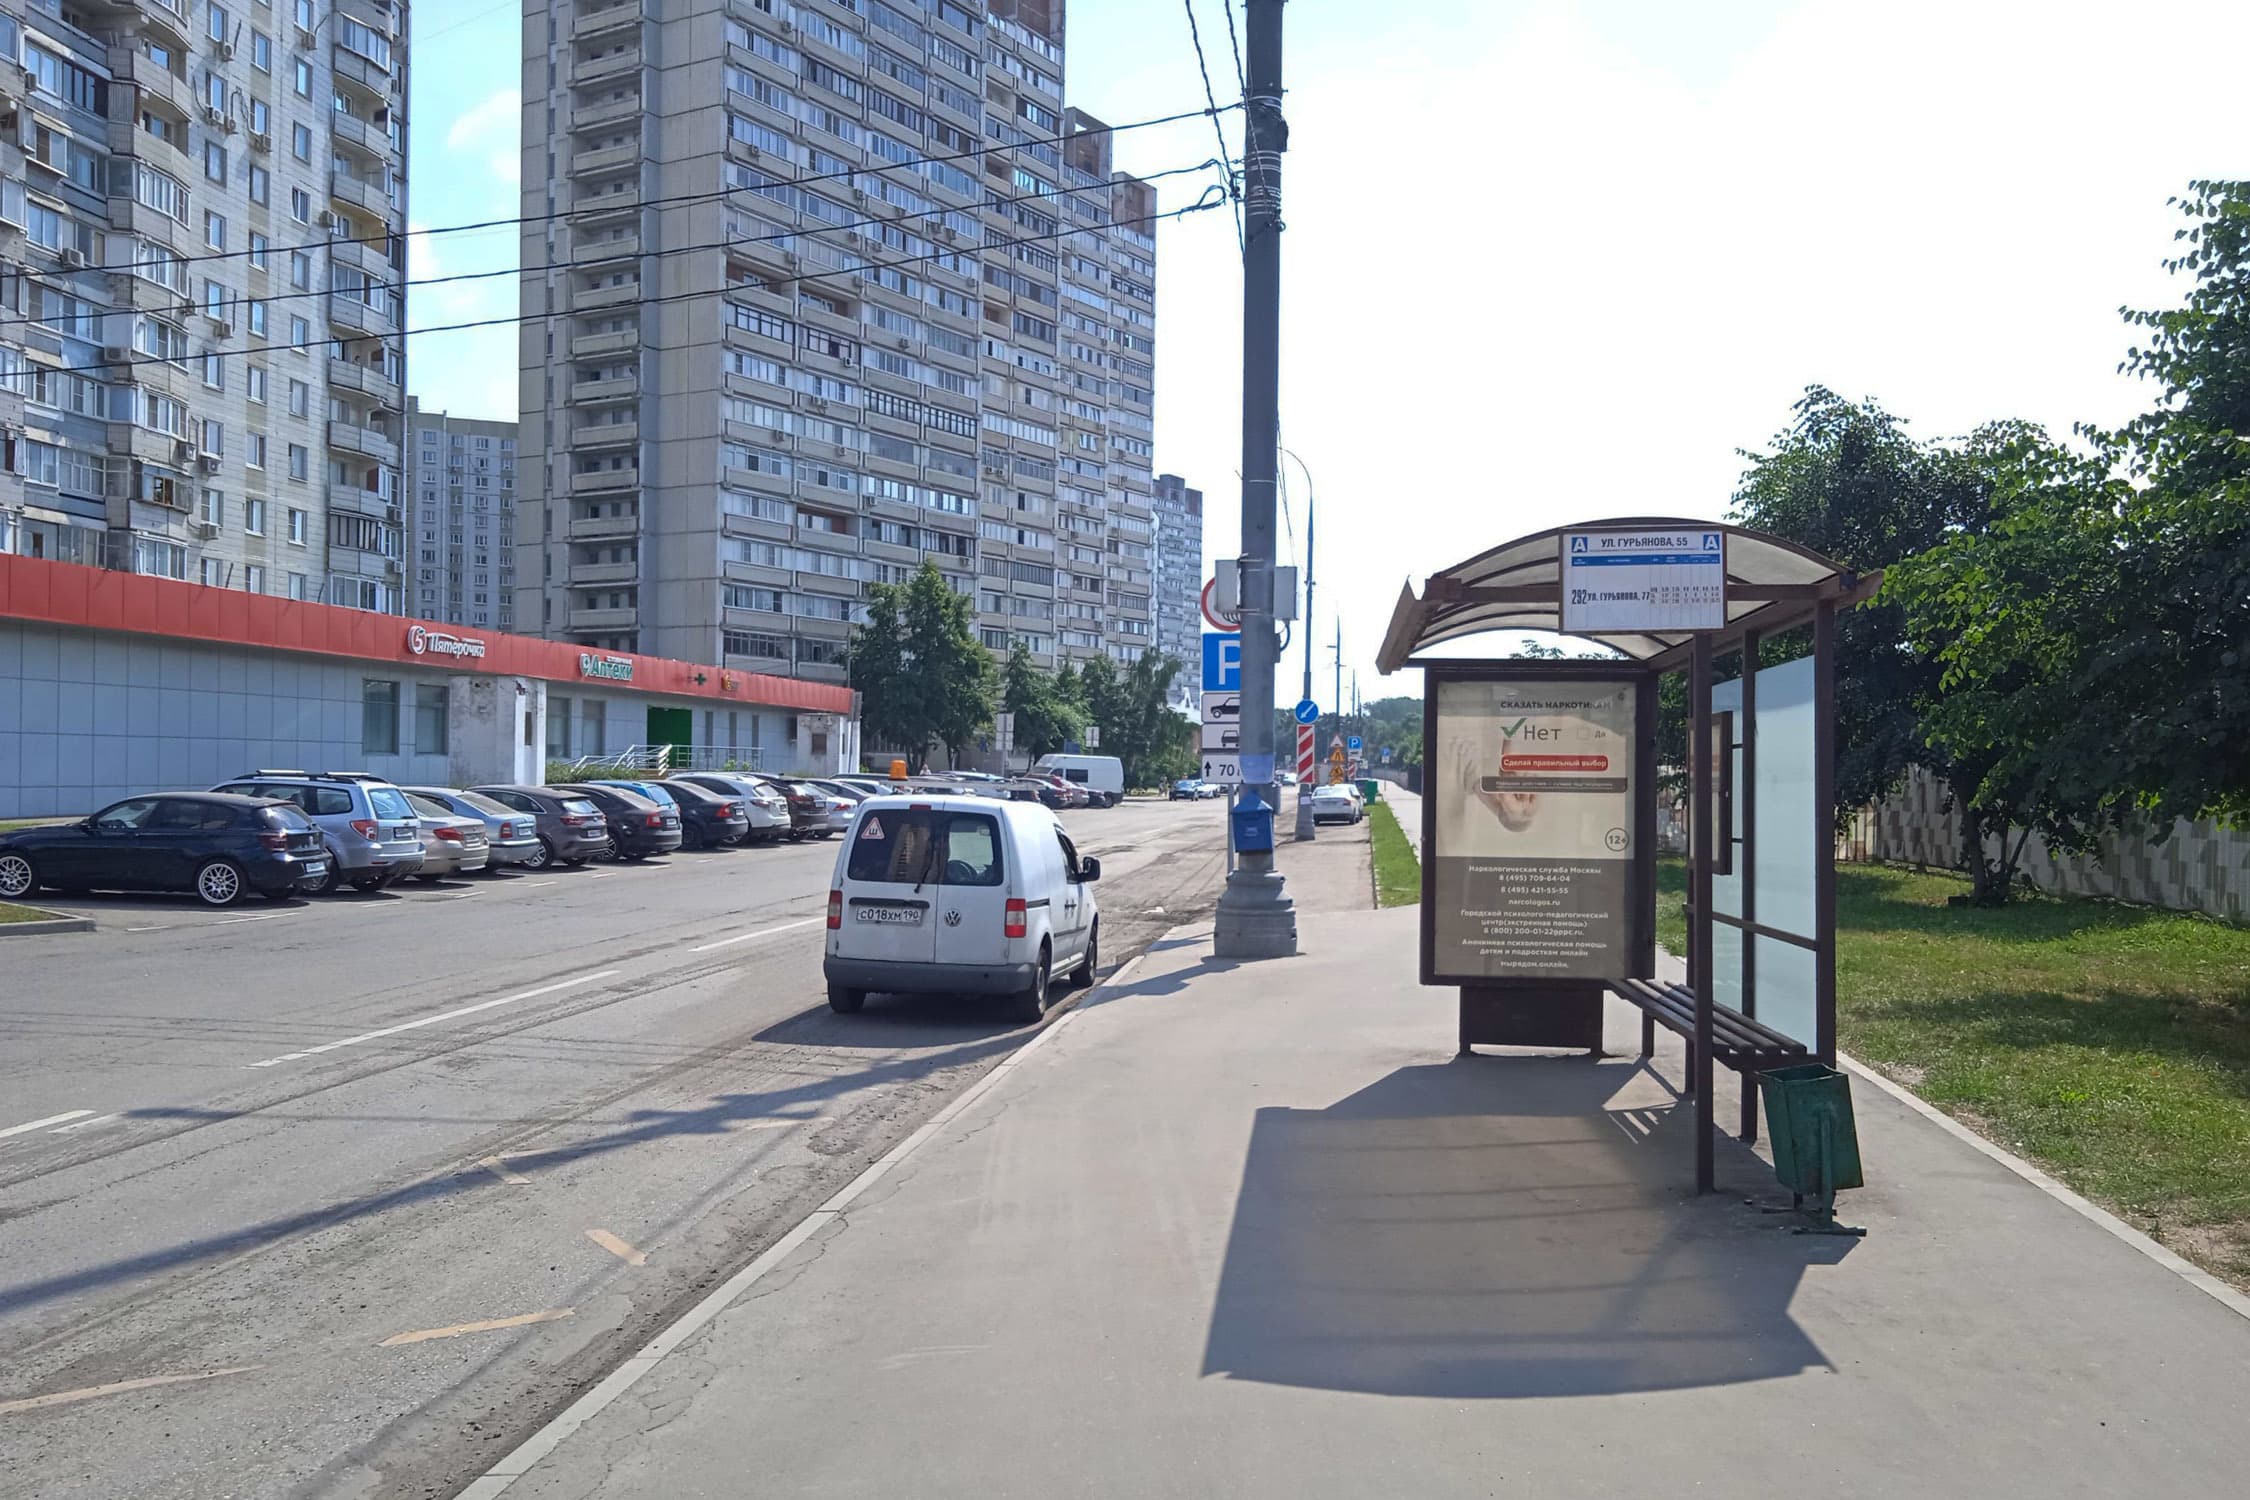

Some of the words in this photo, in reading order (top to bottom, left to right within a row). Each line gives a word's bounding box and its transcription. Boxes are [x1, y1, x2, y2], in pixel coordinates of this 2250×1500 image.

[1601, 538, 1616, 548] УЛ.
[1618, 536, 1675, 548] ГУРЬЯНОВА,
[1677, 536, 1688, 546] 55
[1571, 589, 1587, 605] 292
[1587, 591, 1599, 602] УЛ.
[1600, 591, 1640, 601] ГУРЬЯНОВА,
[1641, 591, 1650, 601] 77
[591, 658, 633, 681] Аптеки
[1500, 700, 1543, 709] СКАЗАТЬ
[1524, 725, 1563, 741] Нет
[1594, 730, 1606, 739] Да
[1503, 758, 1532, 767] Сделай
[1533, 759, 1580, 767] правильный
[1581, 759, 1607, 768] выбор
[1219, 764, 1235, 777] 70
[1608, 835, 1626, 845] 12+
[1469, 865, 1537, 874] Наркологическая
[1538, 867, 1568, 875] служба
[1505, 874, 1527, 882] (495)
[1507, 886, 1529, 894] (495)
[1508, 899, 1561, 907] narcologos.ru
[903, 910, 919, 919] 190
[1460, 909, 1502, 918] Городской
[1507, 940, 1574, 948] психологическая
